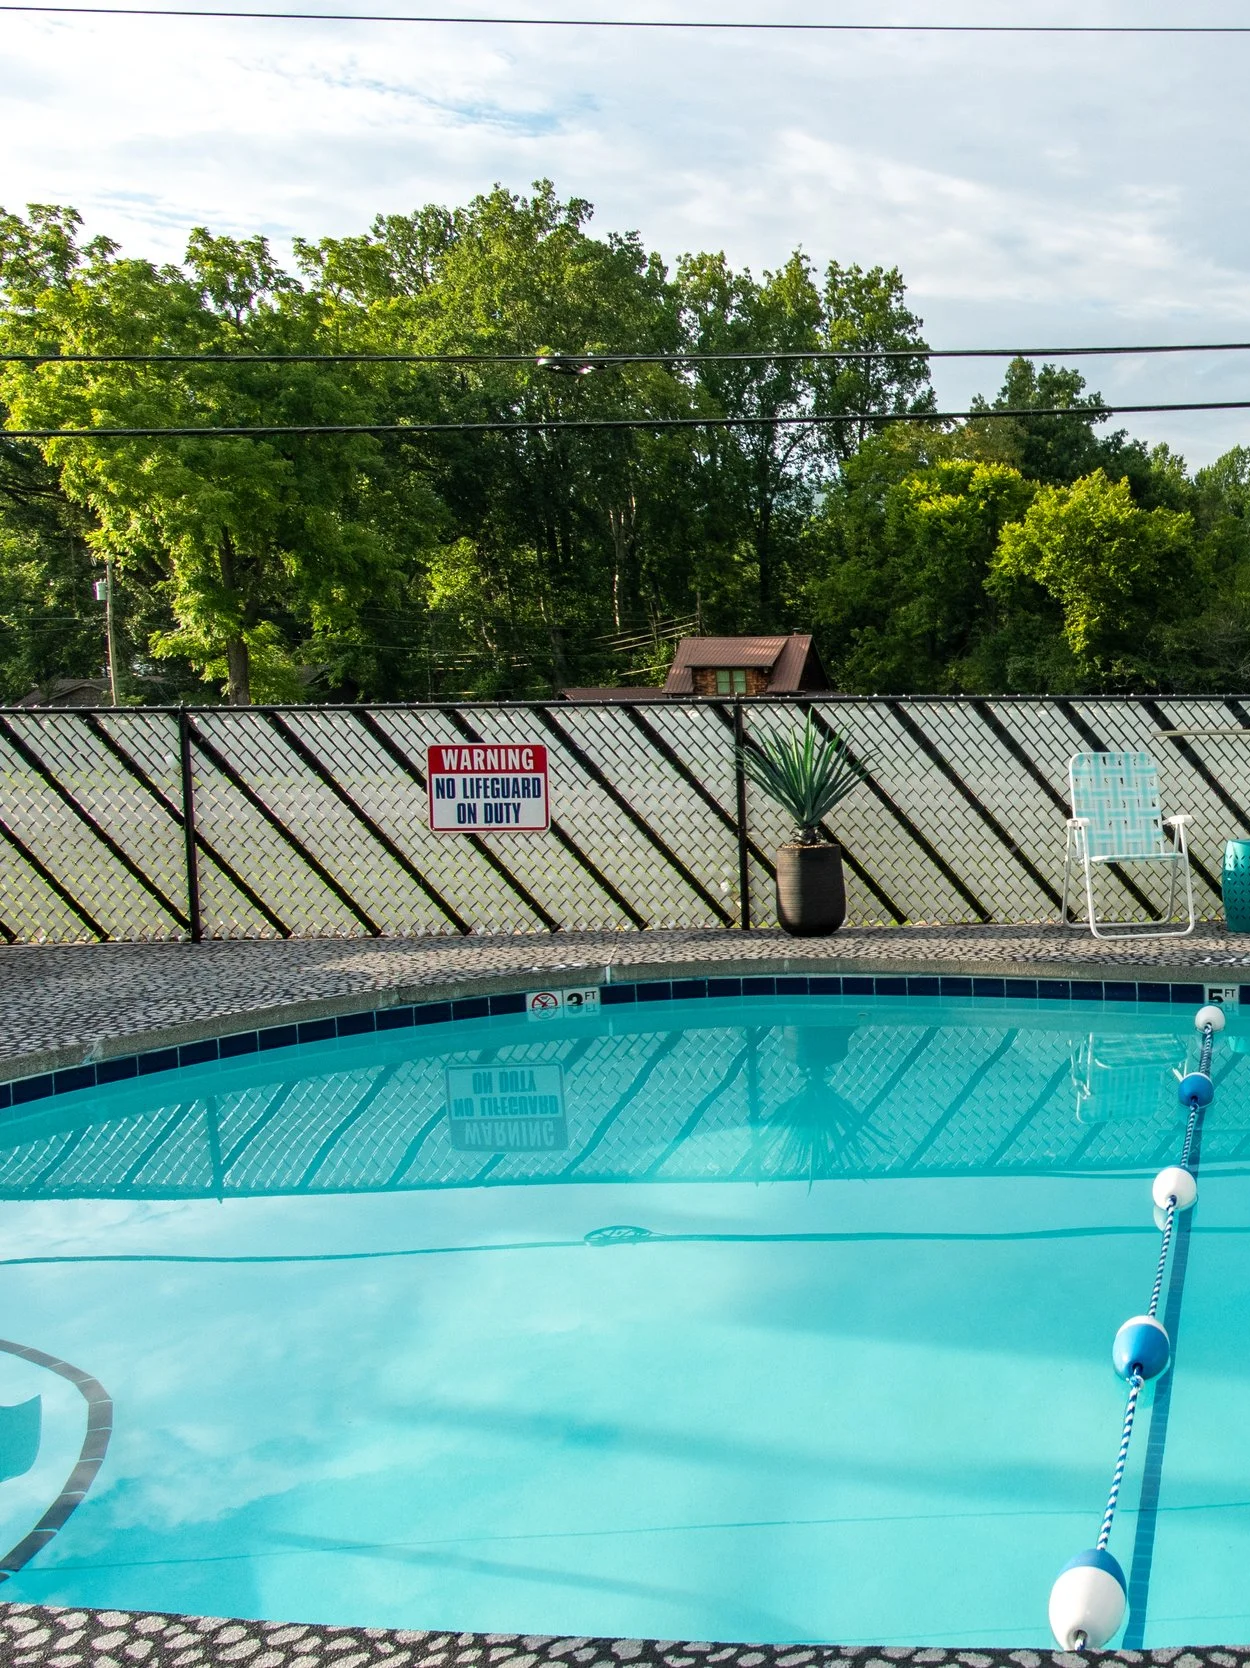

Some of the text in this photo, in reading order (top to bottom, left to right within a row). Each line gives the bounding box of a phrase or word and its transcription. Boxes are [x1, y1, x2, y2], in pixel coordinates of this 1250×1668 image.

[441, 748, 534, 770] WARNING
[435, 777, 541, 799] NO LIFEGUARD
[457, 802, 521, 824] ON DUTY
[585, 991, 597, 1000] FT
[1225, 989, 1236, 998] FT
